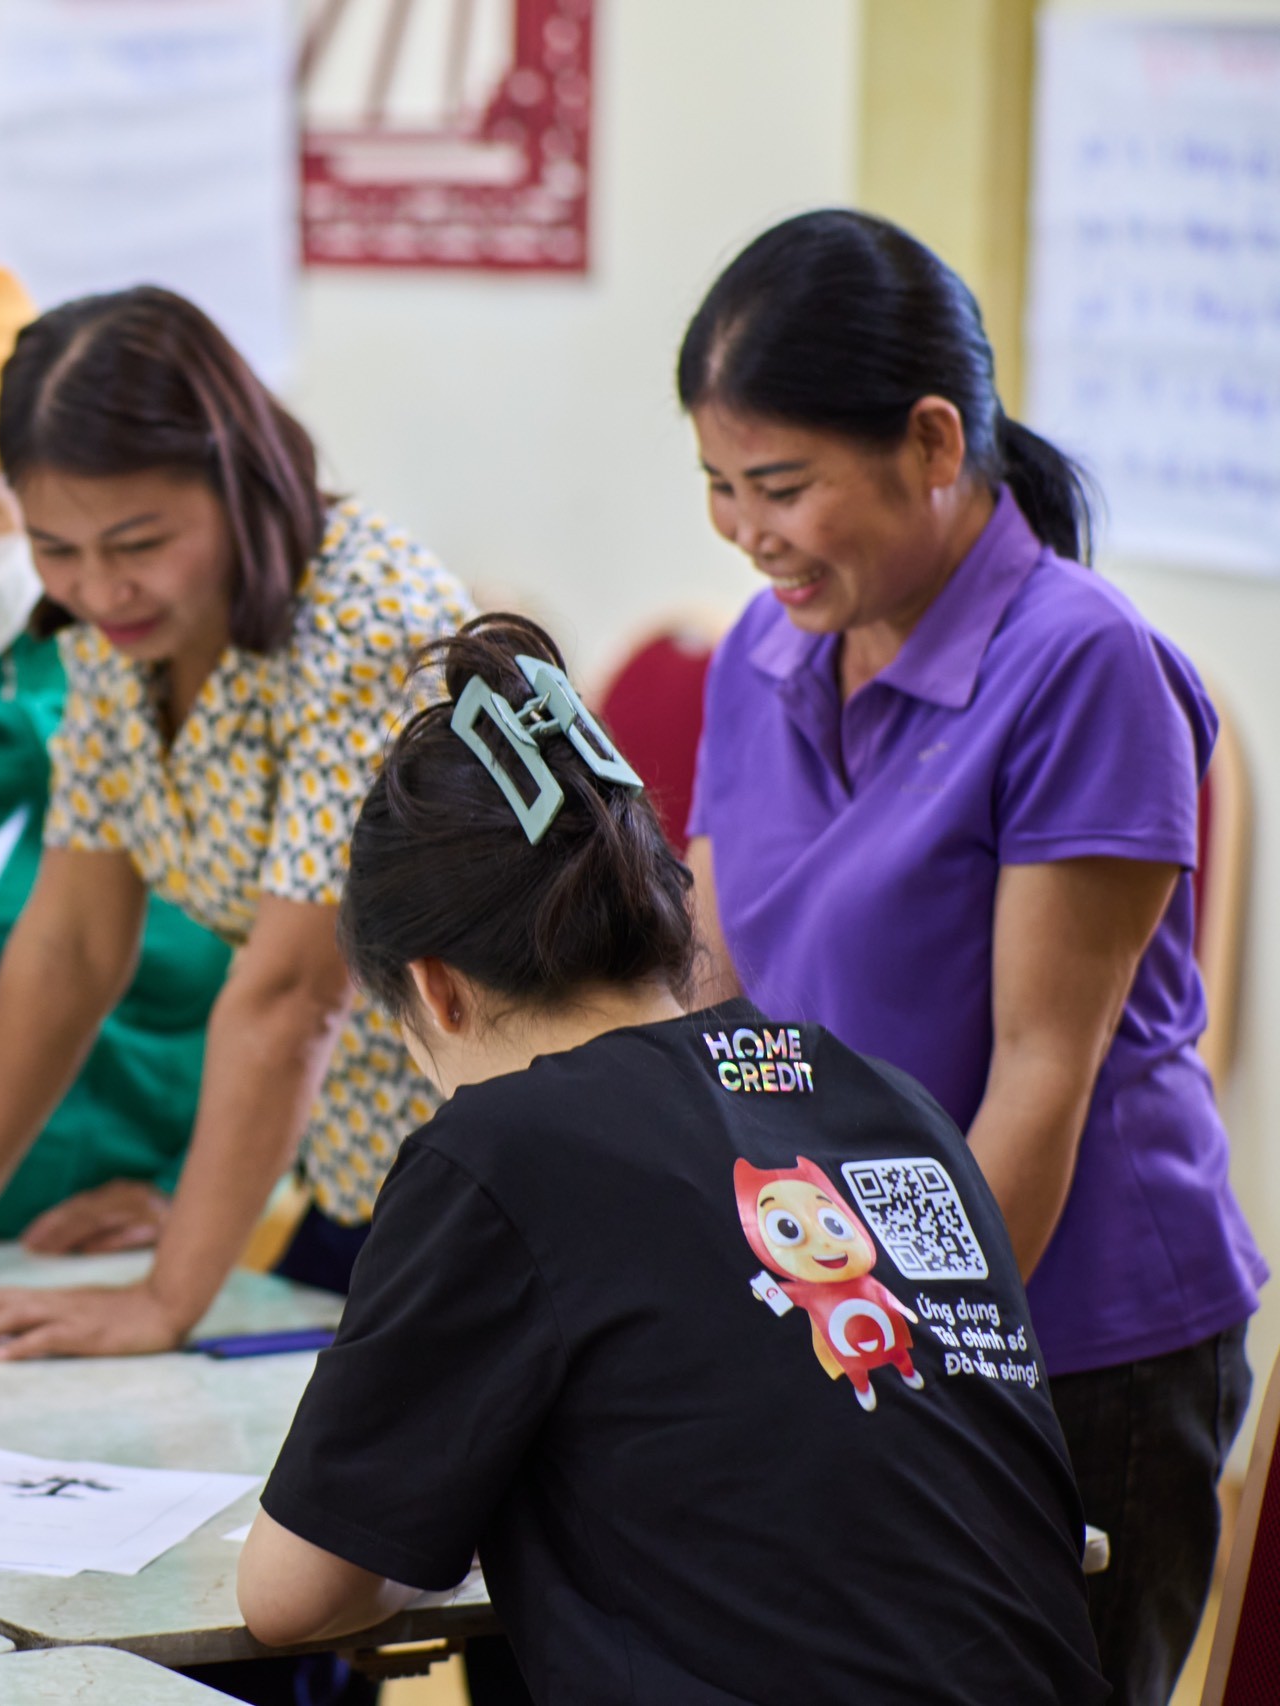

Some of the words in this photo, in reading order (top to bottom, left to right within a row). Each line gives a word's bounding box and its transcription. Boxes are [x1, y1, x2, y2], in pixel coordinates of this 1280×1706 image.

[702, 1027, 802, 1060] HOME
[717, 1061, 814, 1093] CREDIT
[916, 1292, 956, 1326] Ứng
[956, 1297, 1001, 1327] dụng
[961, 1326, 1006, 1351] chính
[1007, 1325, 1028, 1352] số
[944, 1351, 975, 1376] Đã
[1000, 1357, 1040, 1390] sàng!
